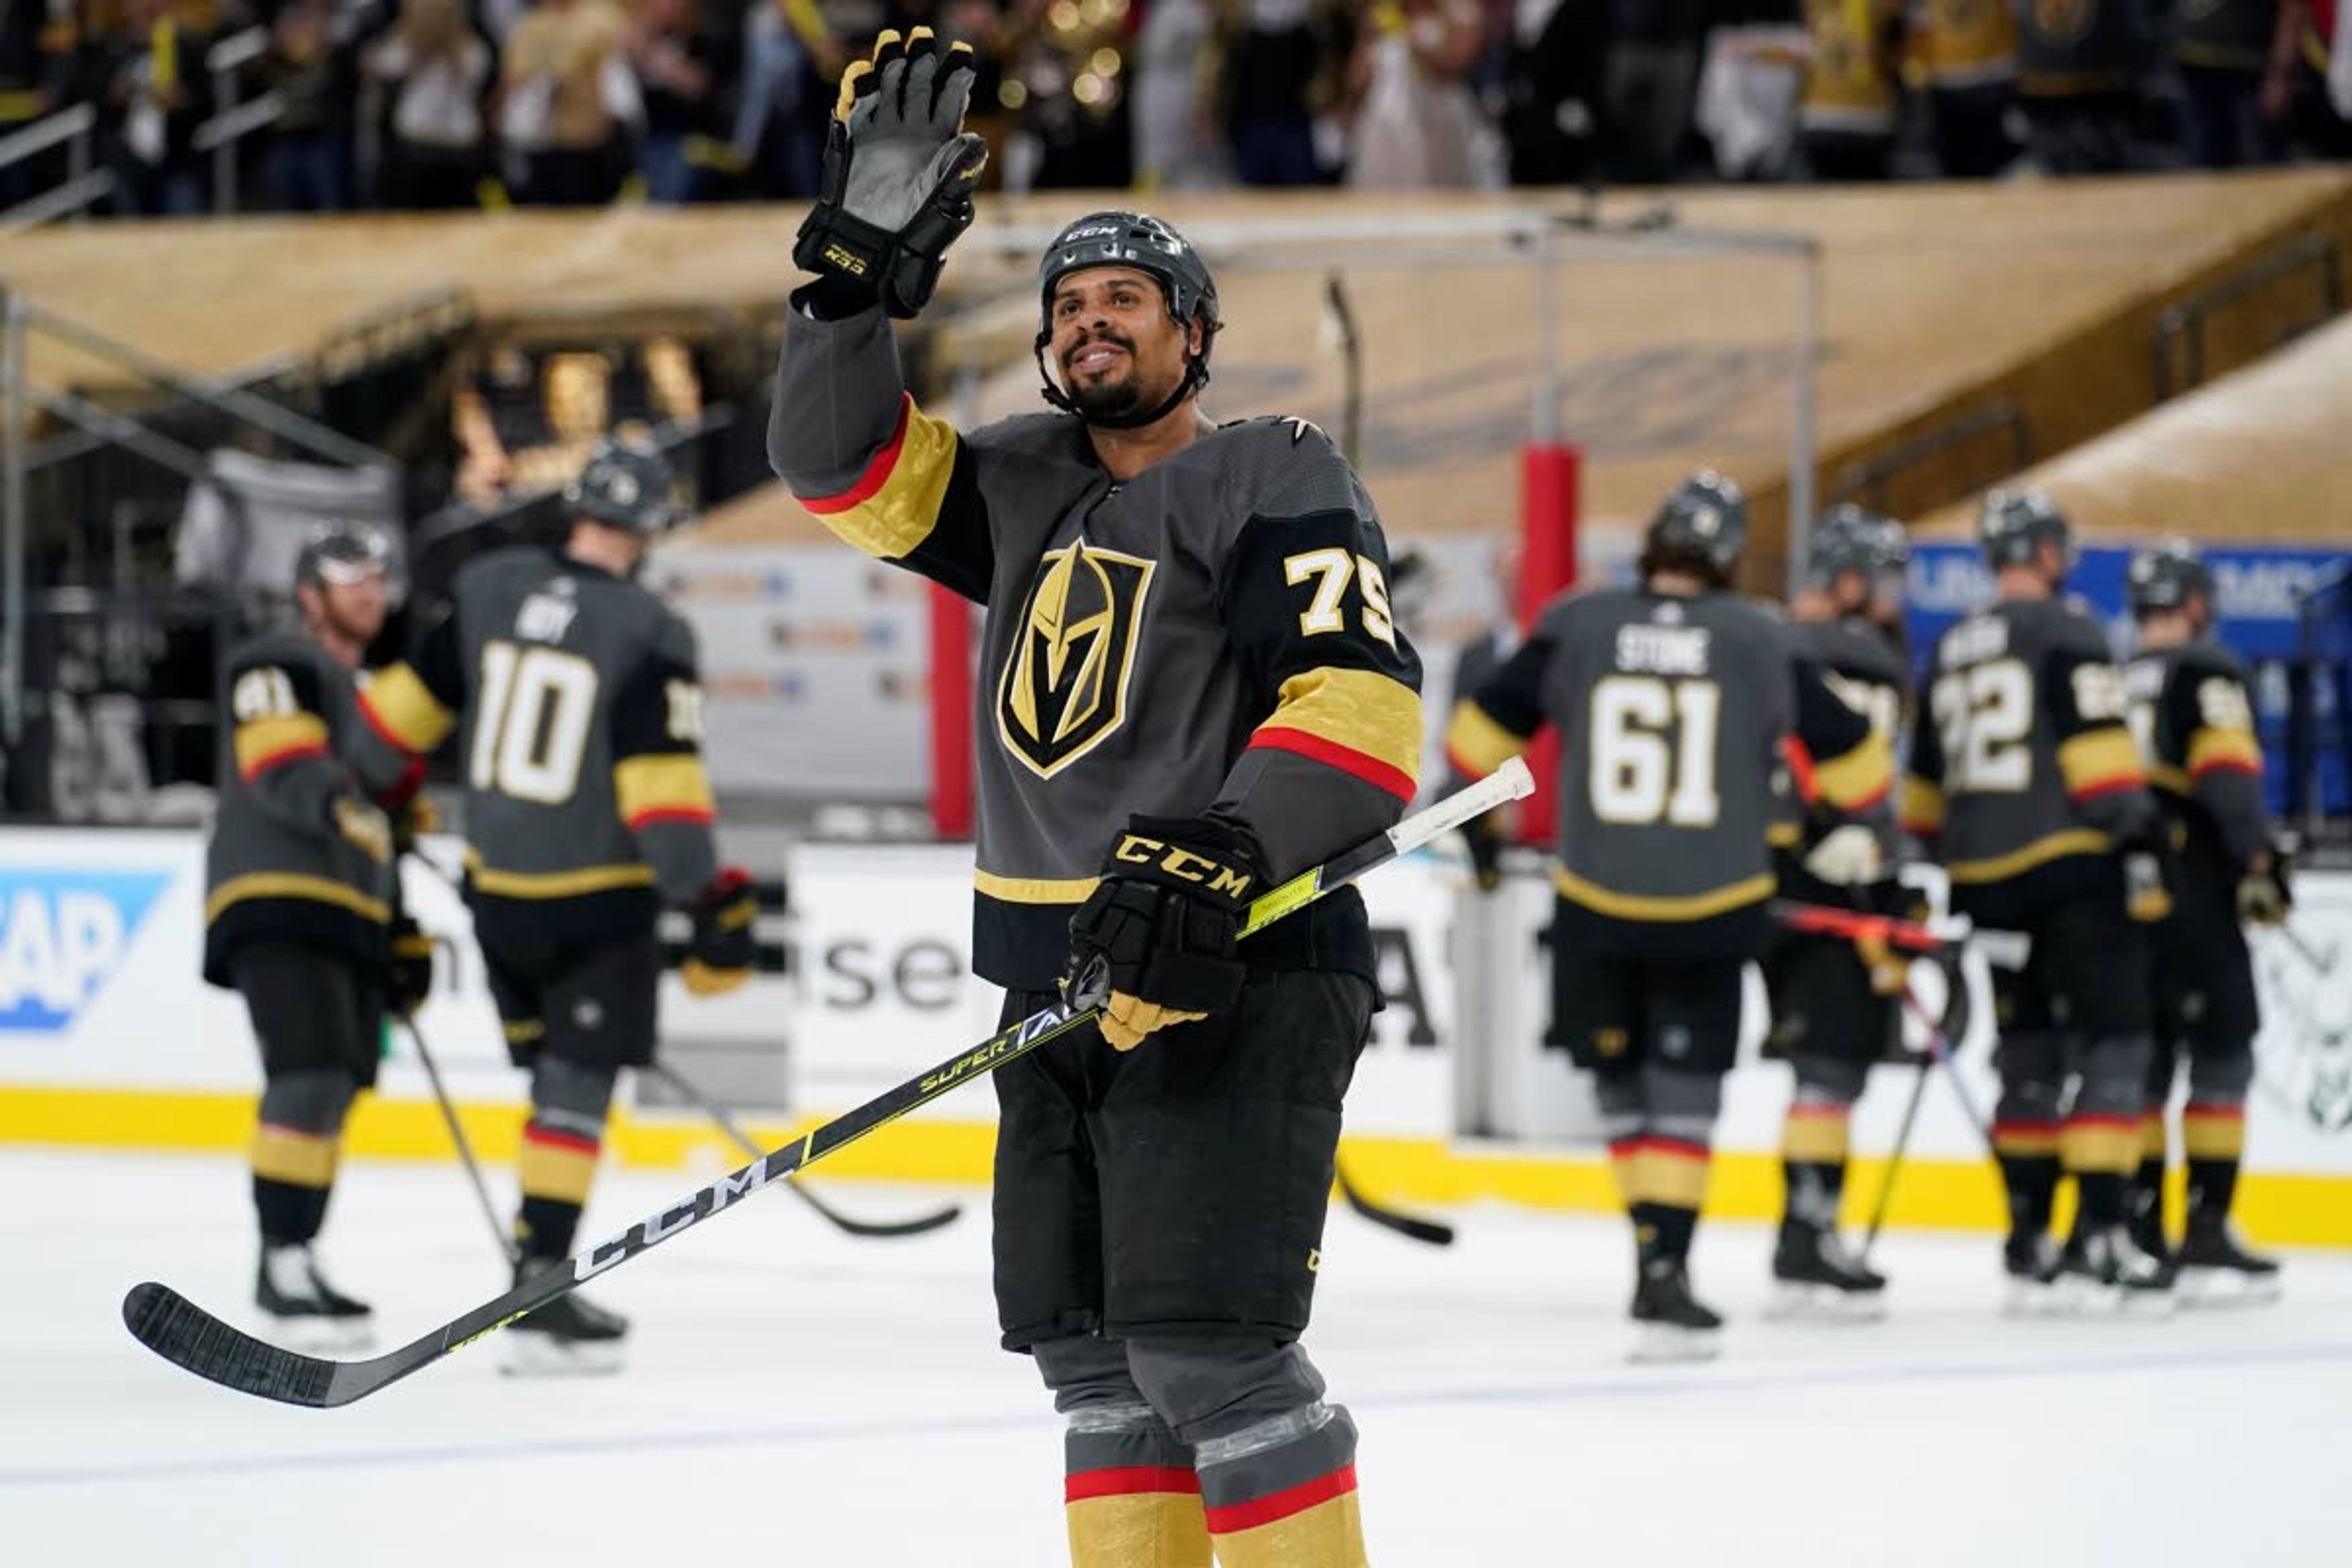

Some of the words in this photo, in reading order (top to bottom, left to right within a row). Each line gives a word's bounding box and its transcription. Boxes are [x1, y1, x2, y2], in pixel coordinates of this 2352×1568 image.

[1066, 226, 1119, 243] CCM
[1284, 548, 1397, 652] 75
[471, 638, 600, 805] 10
[1588, 676, 1722, 829] 61
[1115, 834, 1252, 893] CCM
[919, 1038, 1007, 1093] SUPER
[573, 1156, 767, 1281] CCM
